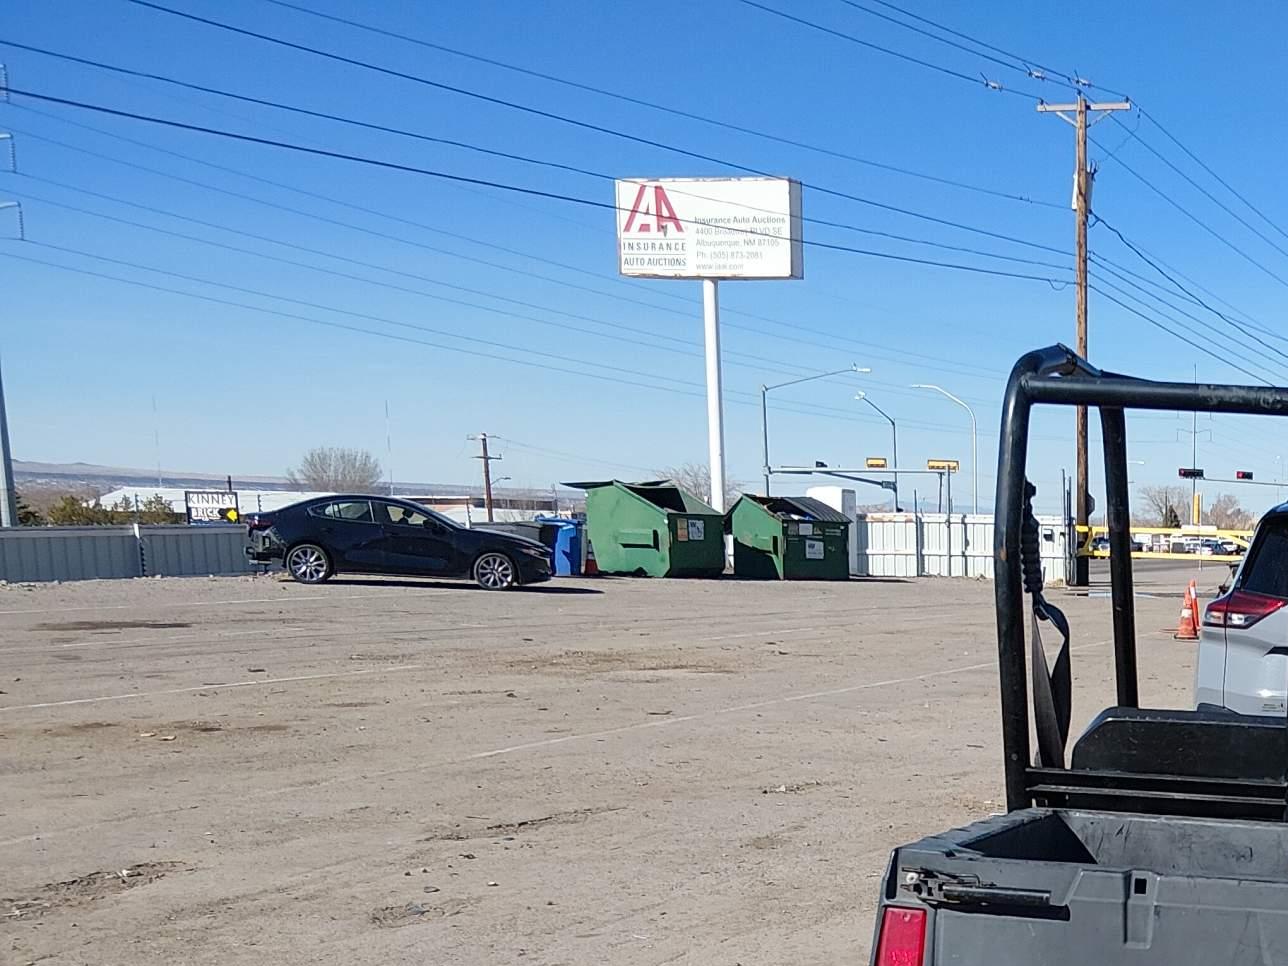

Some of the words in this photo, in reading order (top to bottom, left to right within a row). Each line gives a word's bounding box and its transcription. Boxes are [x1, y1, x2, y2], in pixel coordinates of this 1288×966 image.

[694, 215, 731, 225] Insurance
[733, 215, 750, 224] Auto
[752, 215, 786, 225] Auctions
[695, 227, 713, 236] 4400
[772, 226, 783, 236] SE
[623, 241, 686, 251] INSURANCE
[743, 238, 756, 247] NM
[623, 257, 645, 266] AUTO
[646, 257, 687, 267] AUCTIONS
[188, 493, 234, 505] KINNEY
[192, 507, 222, 519] BRICK
